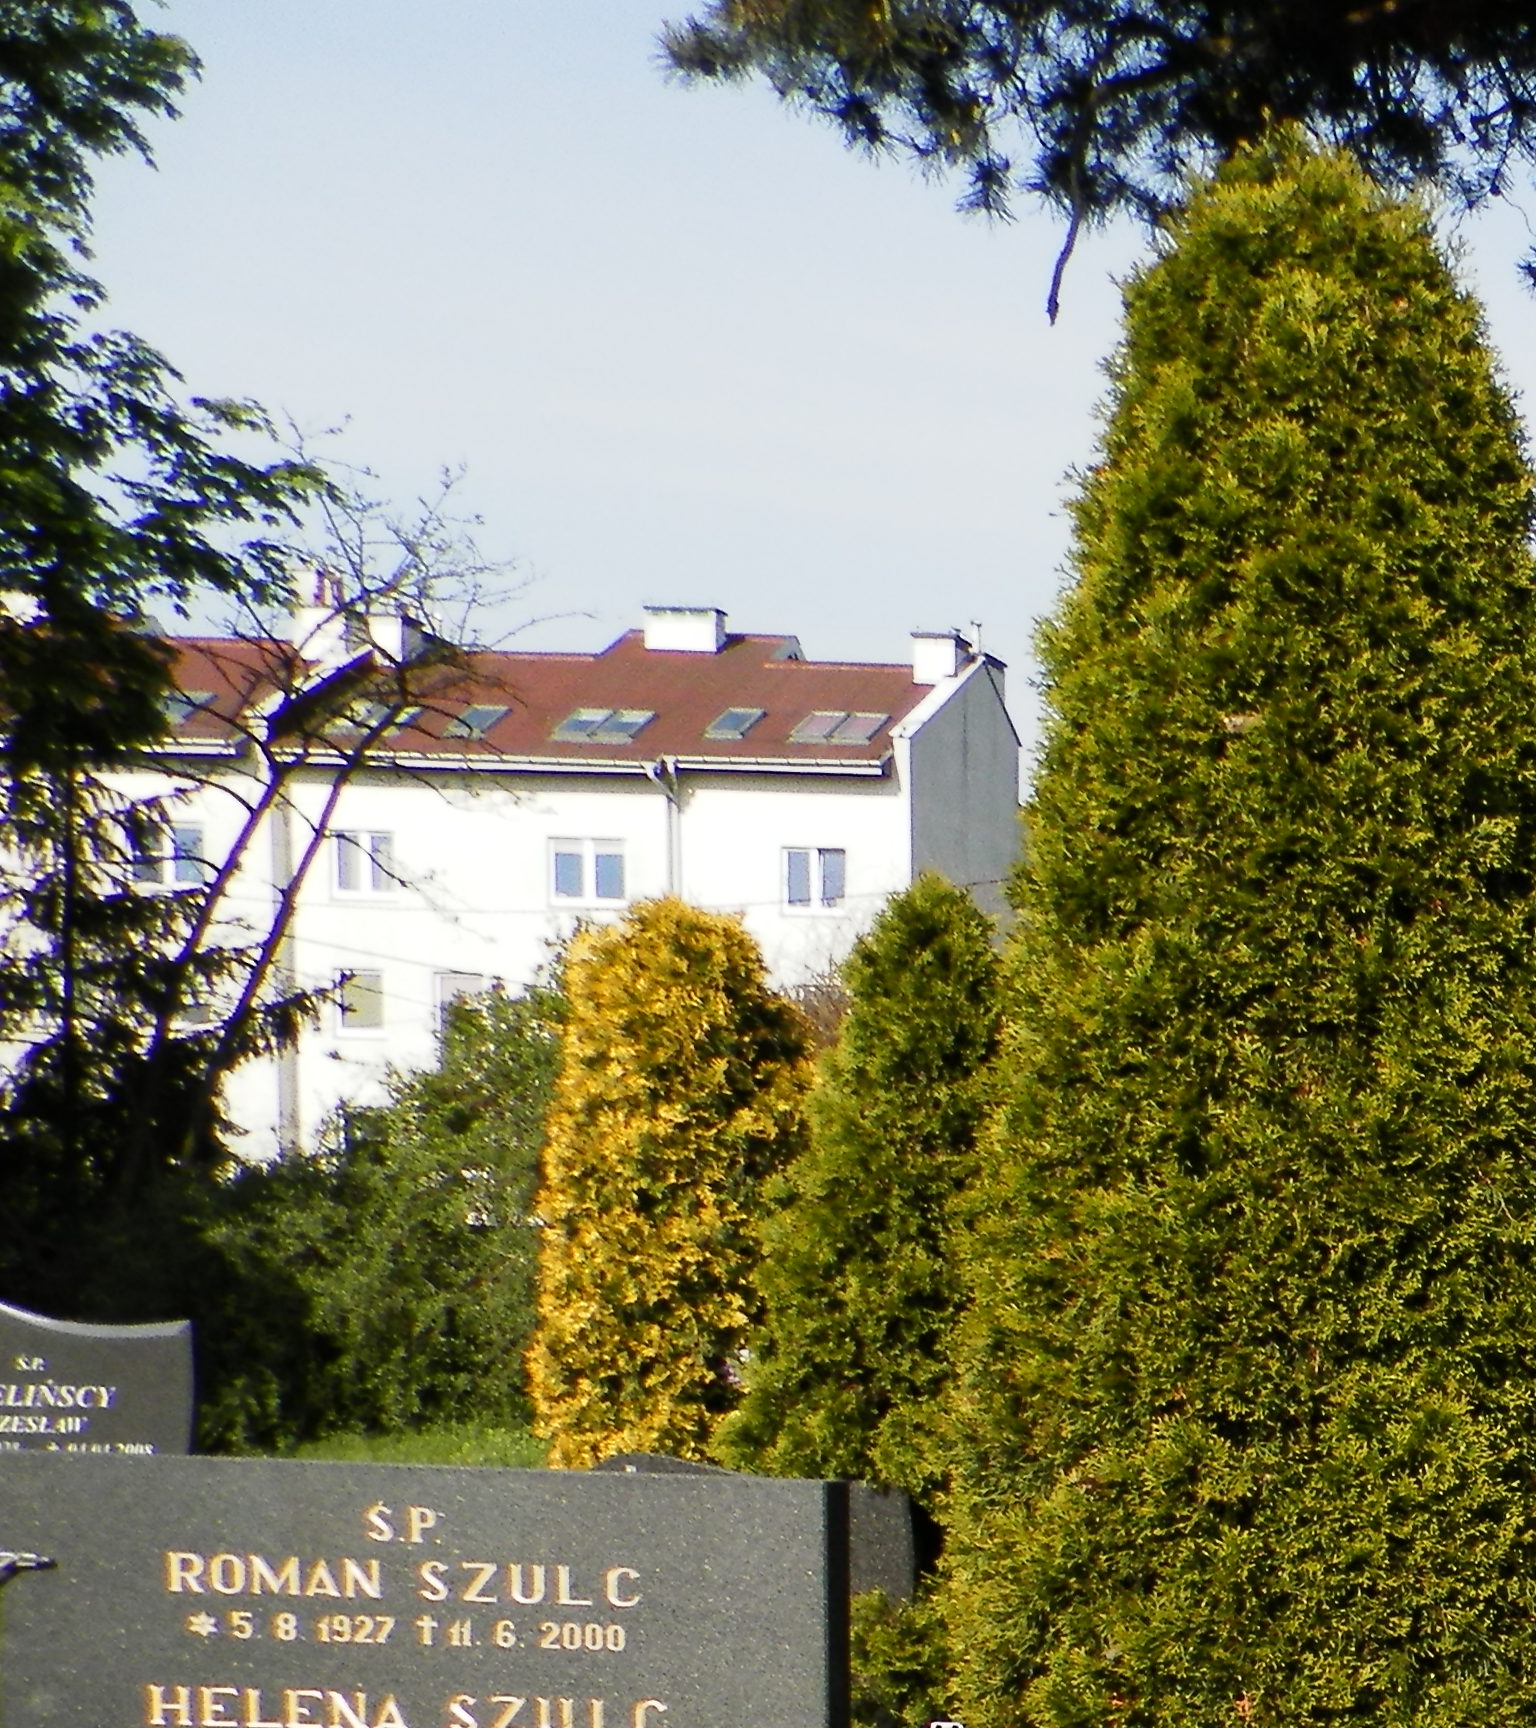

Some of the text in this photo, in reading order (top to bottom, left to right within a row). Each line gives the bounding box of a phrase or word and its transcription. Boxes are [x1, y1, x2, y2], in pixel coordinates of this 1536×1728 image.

[163, 1551, 642, 1608] ROMAN SZULC
[538, 1621, 627, 1653] 2000
